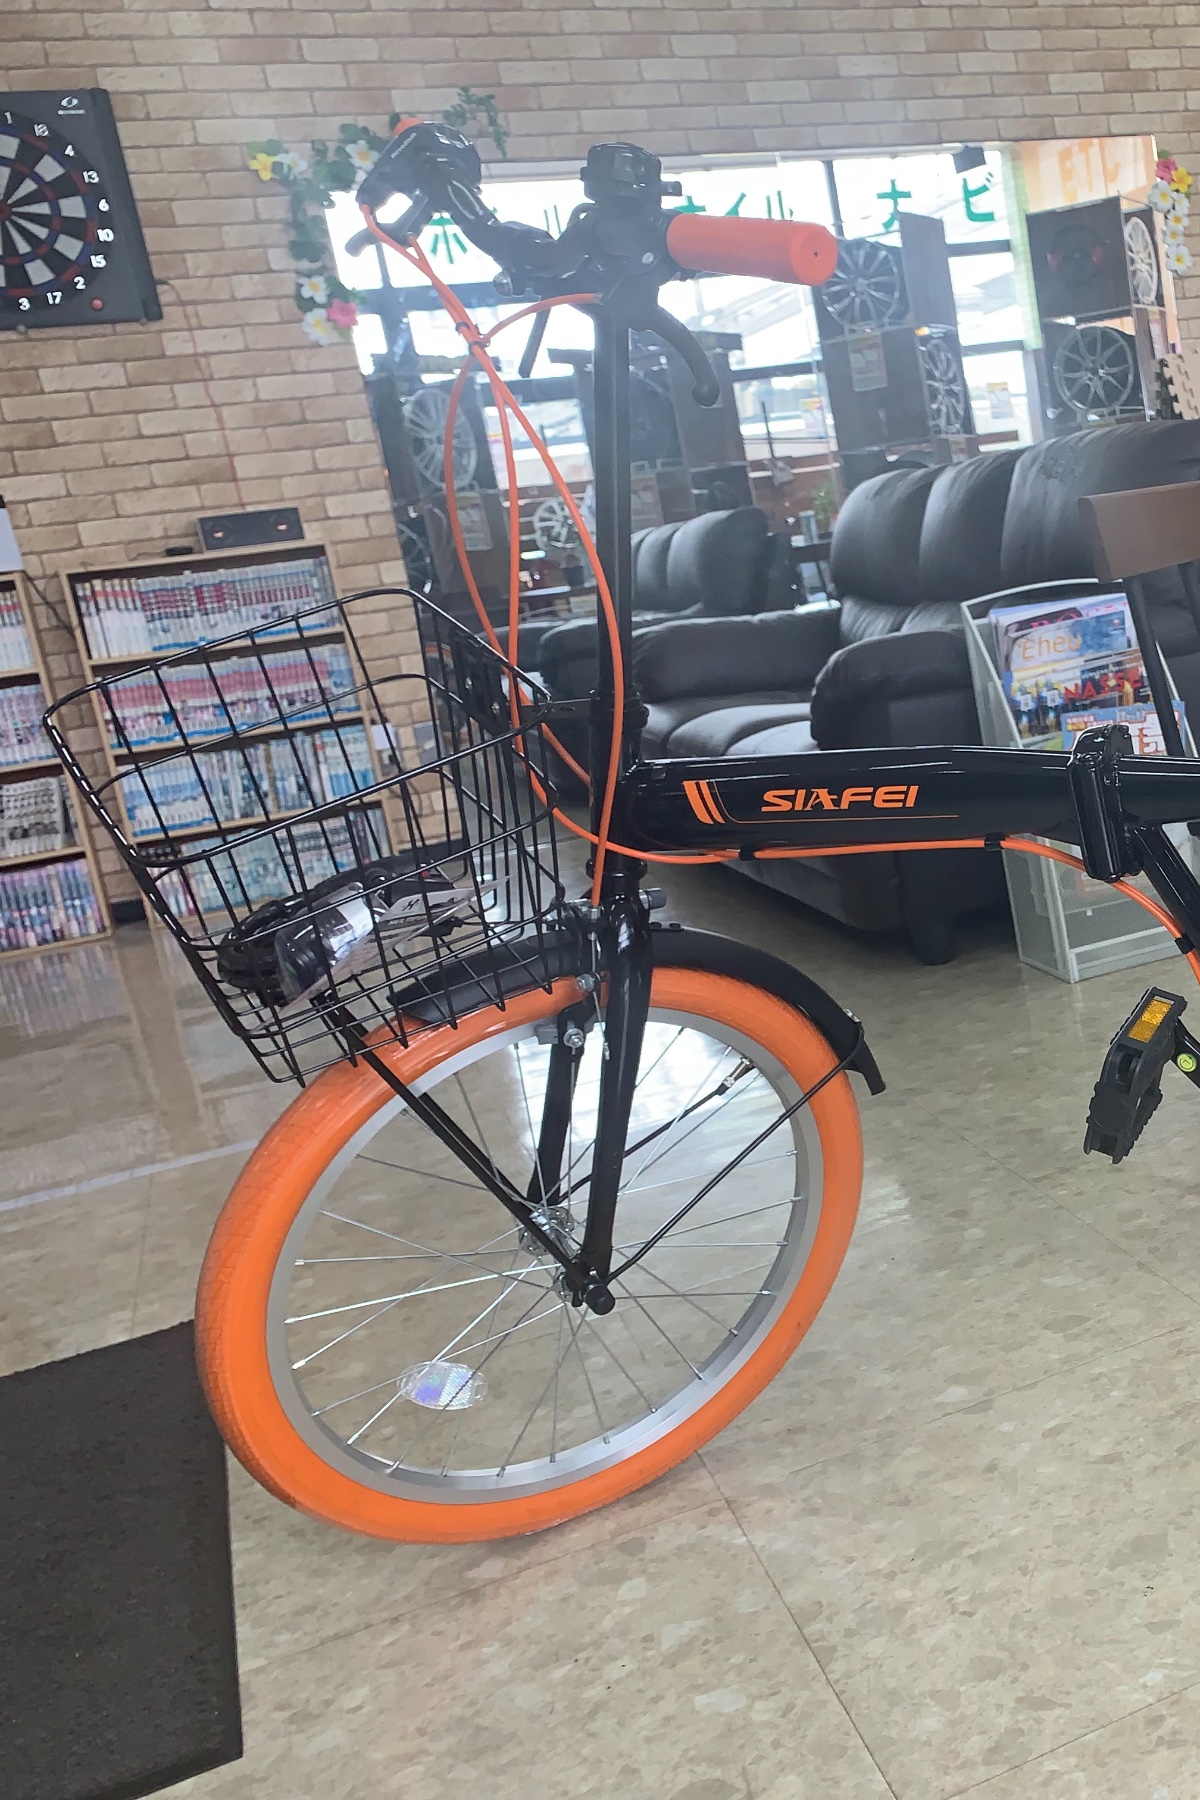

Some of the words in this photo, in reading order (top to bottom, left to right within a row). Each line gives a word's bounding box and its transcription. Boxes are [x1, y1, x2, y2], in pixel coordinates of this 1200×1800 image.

[65, 145, 75, 157] 4
[83, 170, 100, 184] 13
[98, 198, 110, 212] 6
[97, 228, 114, 243] 10
[90, 254, 107, 269] 15
[74, 276, 86, 290] 2
[18, 297, 31, 311] 3
[46, 291, 62, 305] 17
[761, 785, 919, 812] SIAFEI
